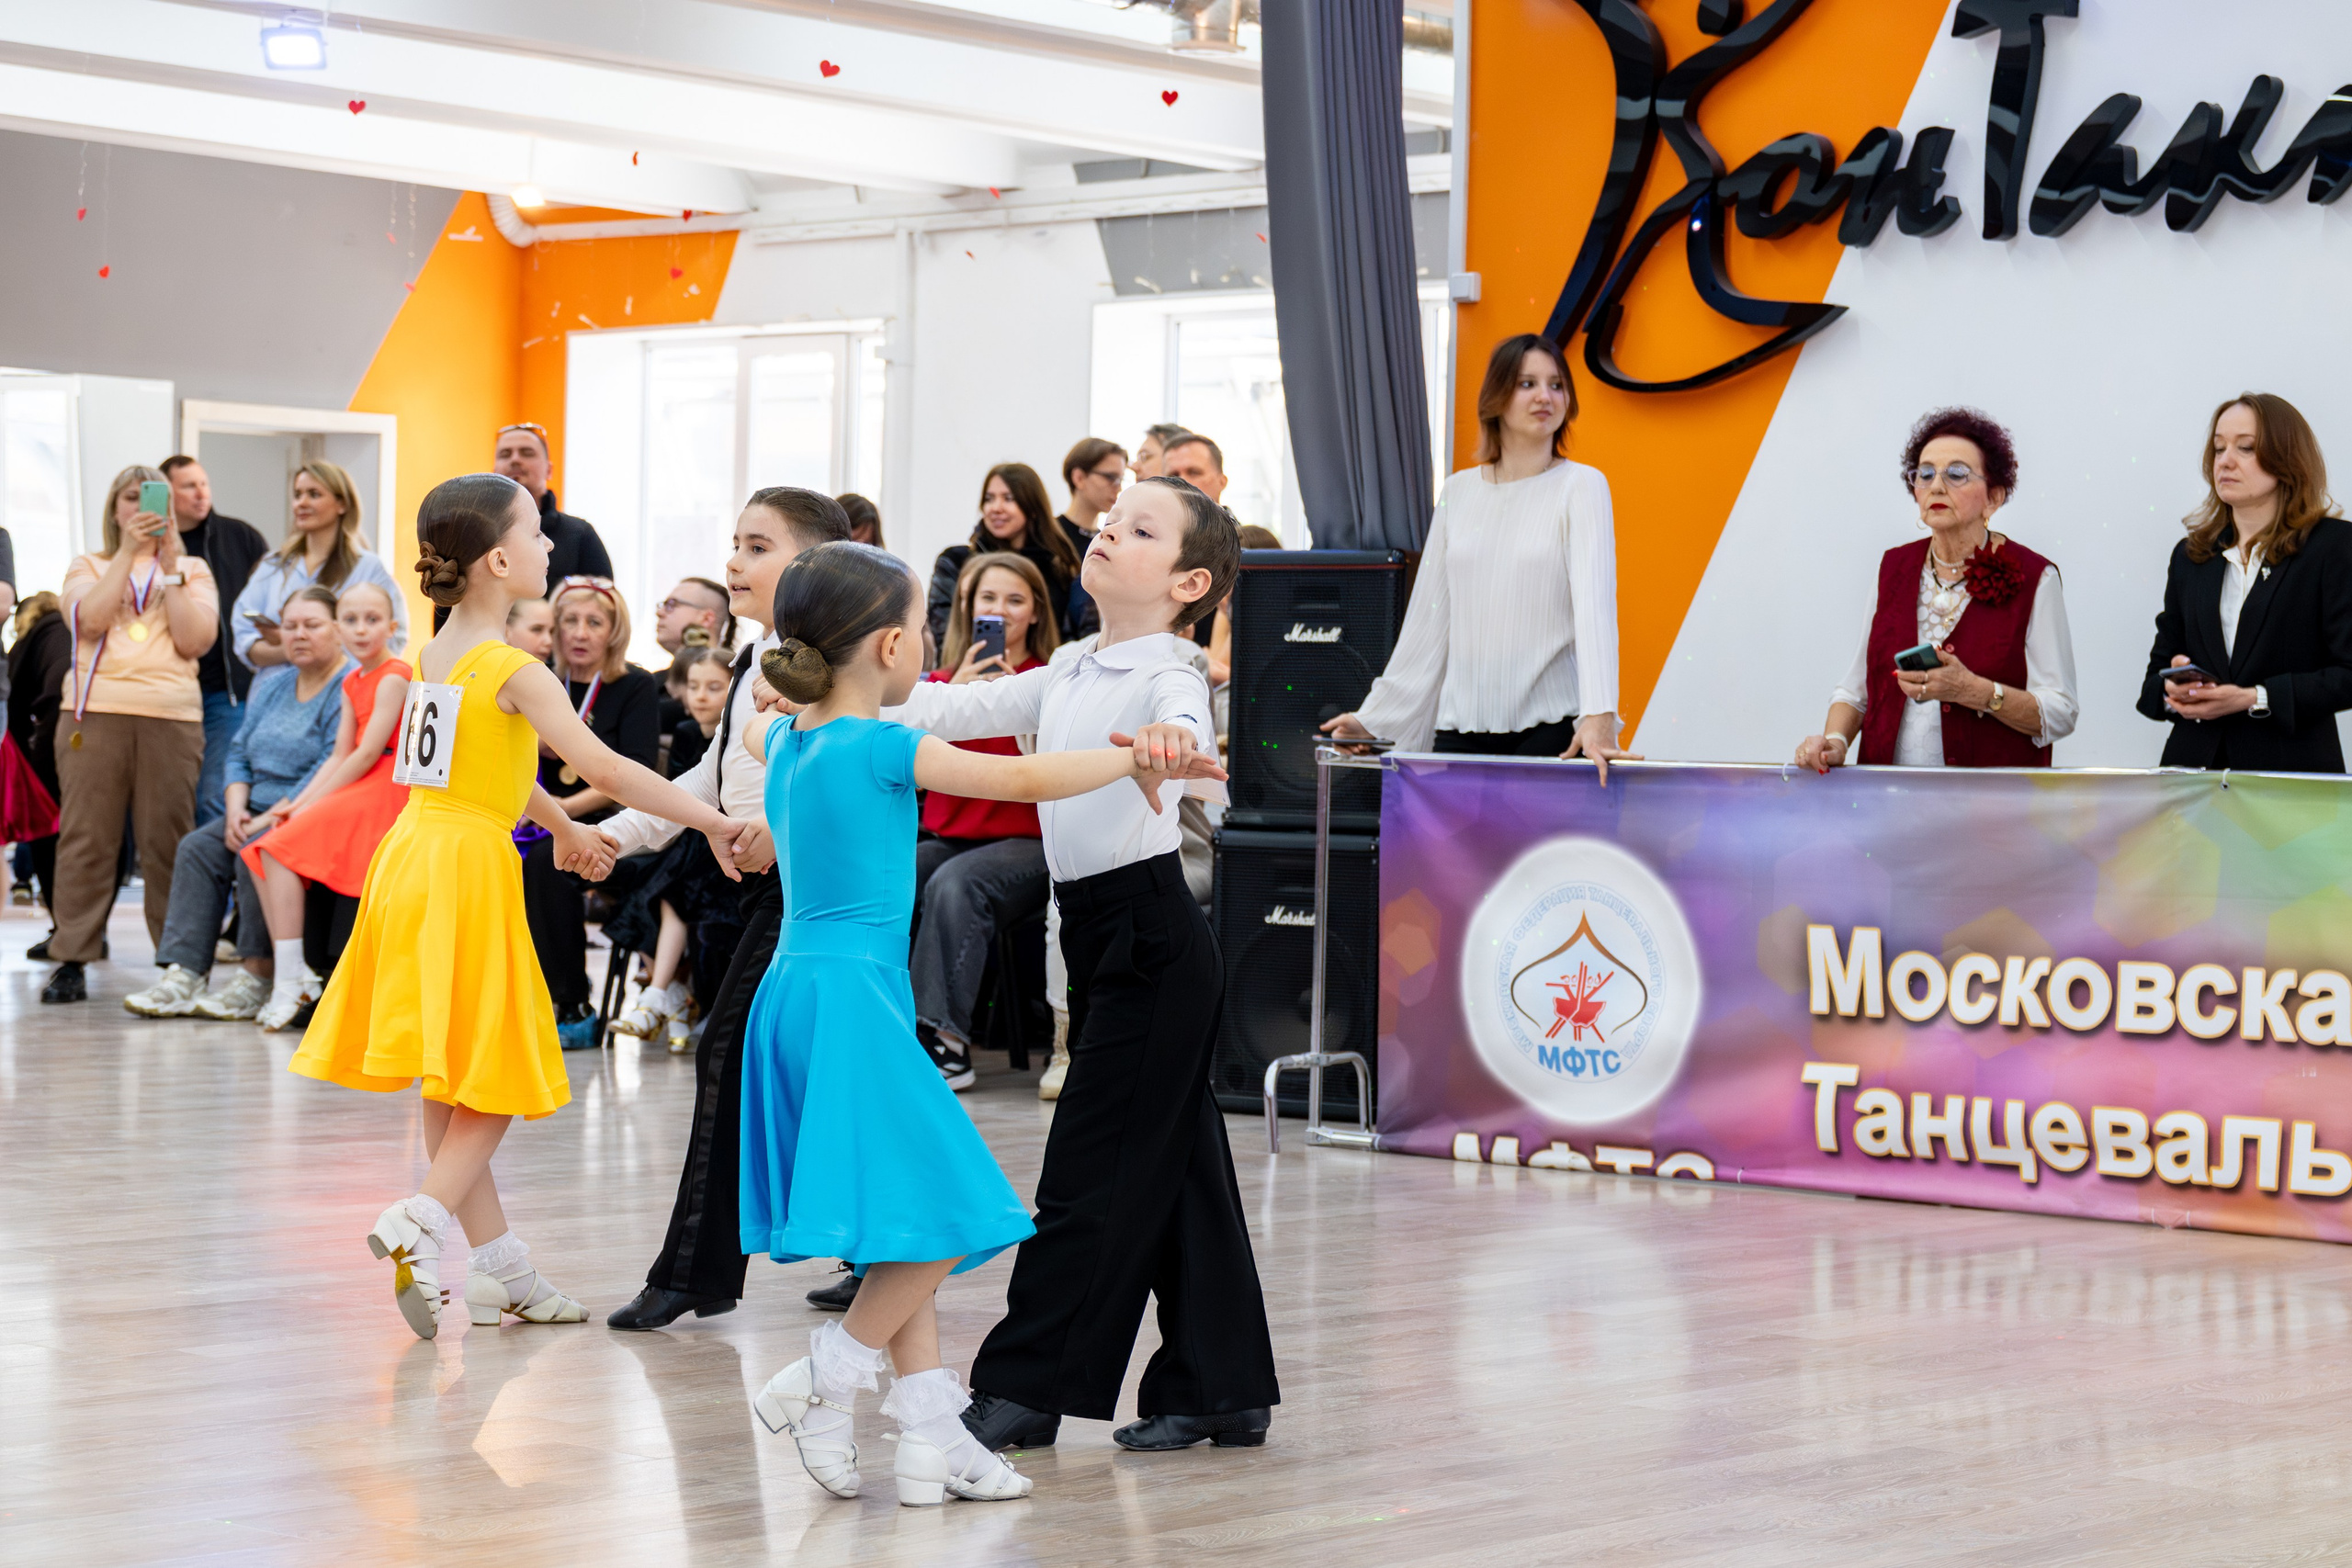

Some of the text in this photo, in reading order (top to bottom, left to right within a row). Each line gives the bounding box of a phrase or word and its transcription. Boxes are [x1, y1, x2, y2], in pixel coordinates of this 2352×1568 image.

[1283, 622, 1342, 643] Marshall
[1512, 886, 1587, 942] ФЕДЕРАЦИЯ
[1806, 924, 2352, 1046] Московска
[1537, 1044, 1622, 1077] МФТС
[1801, 1061, 2352, 1197] Танцеваль
